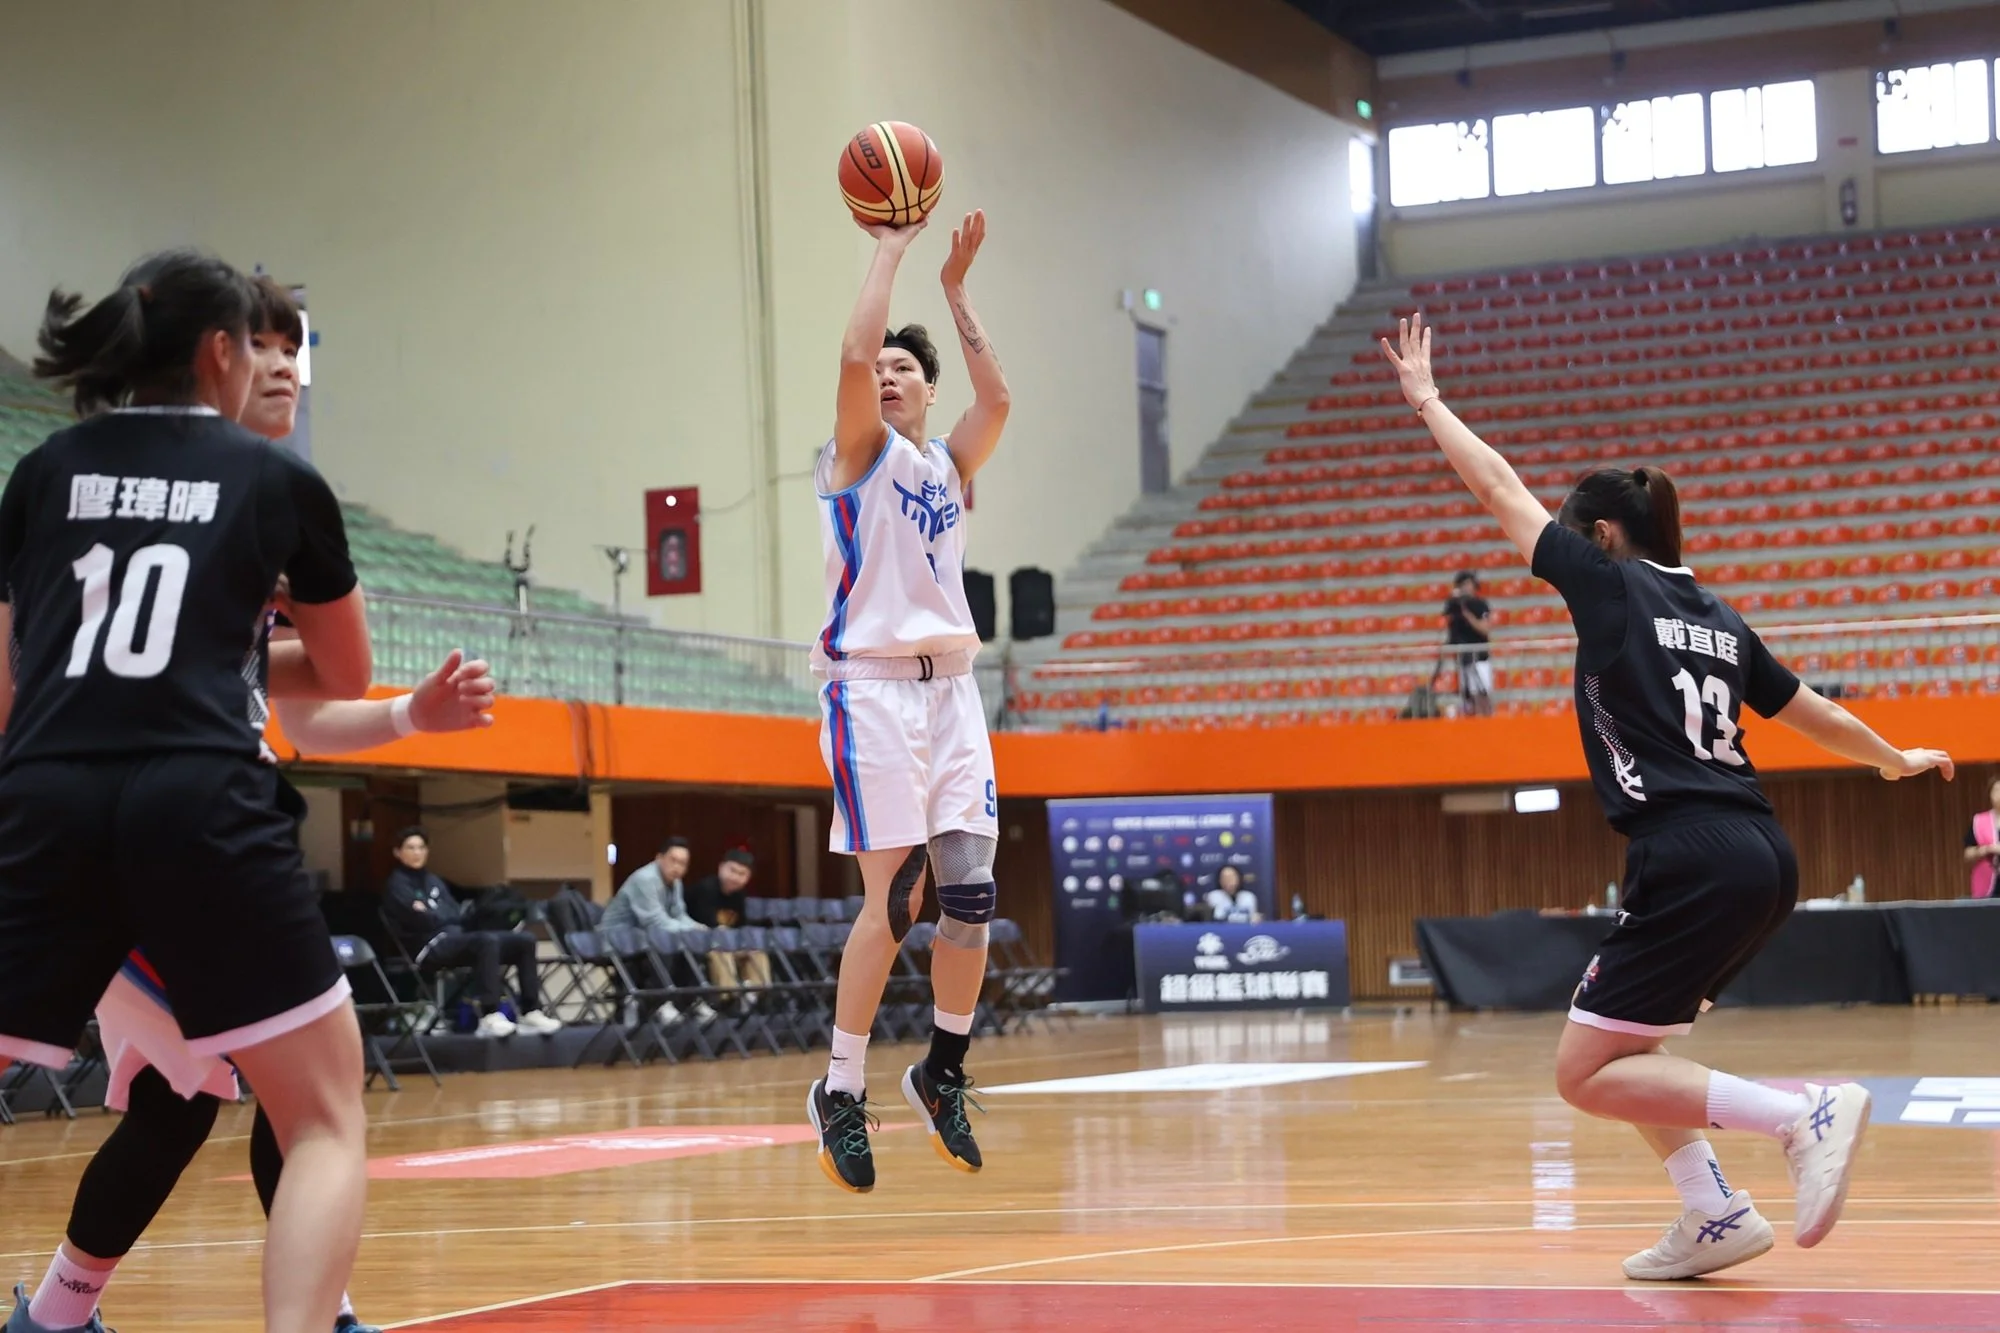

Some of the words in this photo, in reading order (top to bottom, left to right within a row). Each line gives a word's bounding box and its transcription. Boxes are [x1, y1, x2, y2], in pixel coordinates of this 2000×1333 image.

[67, 473, 220, 523] 廖瑋晴
[65, 542, 190, 678] 10
